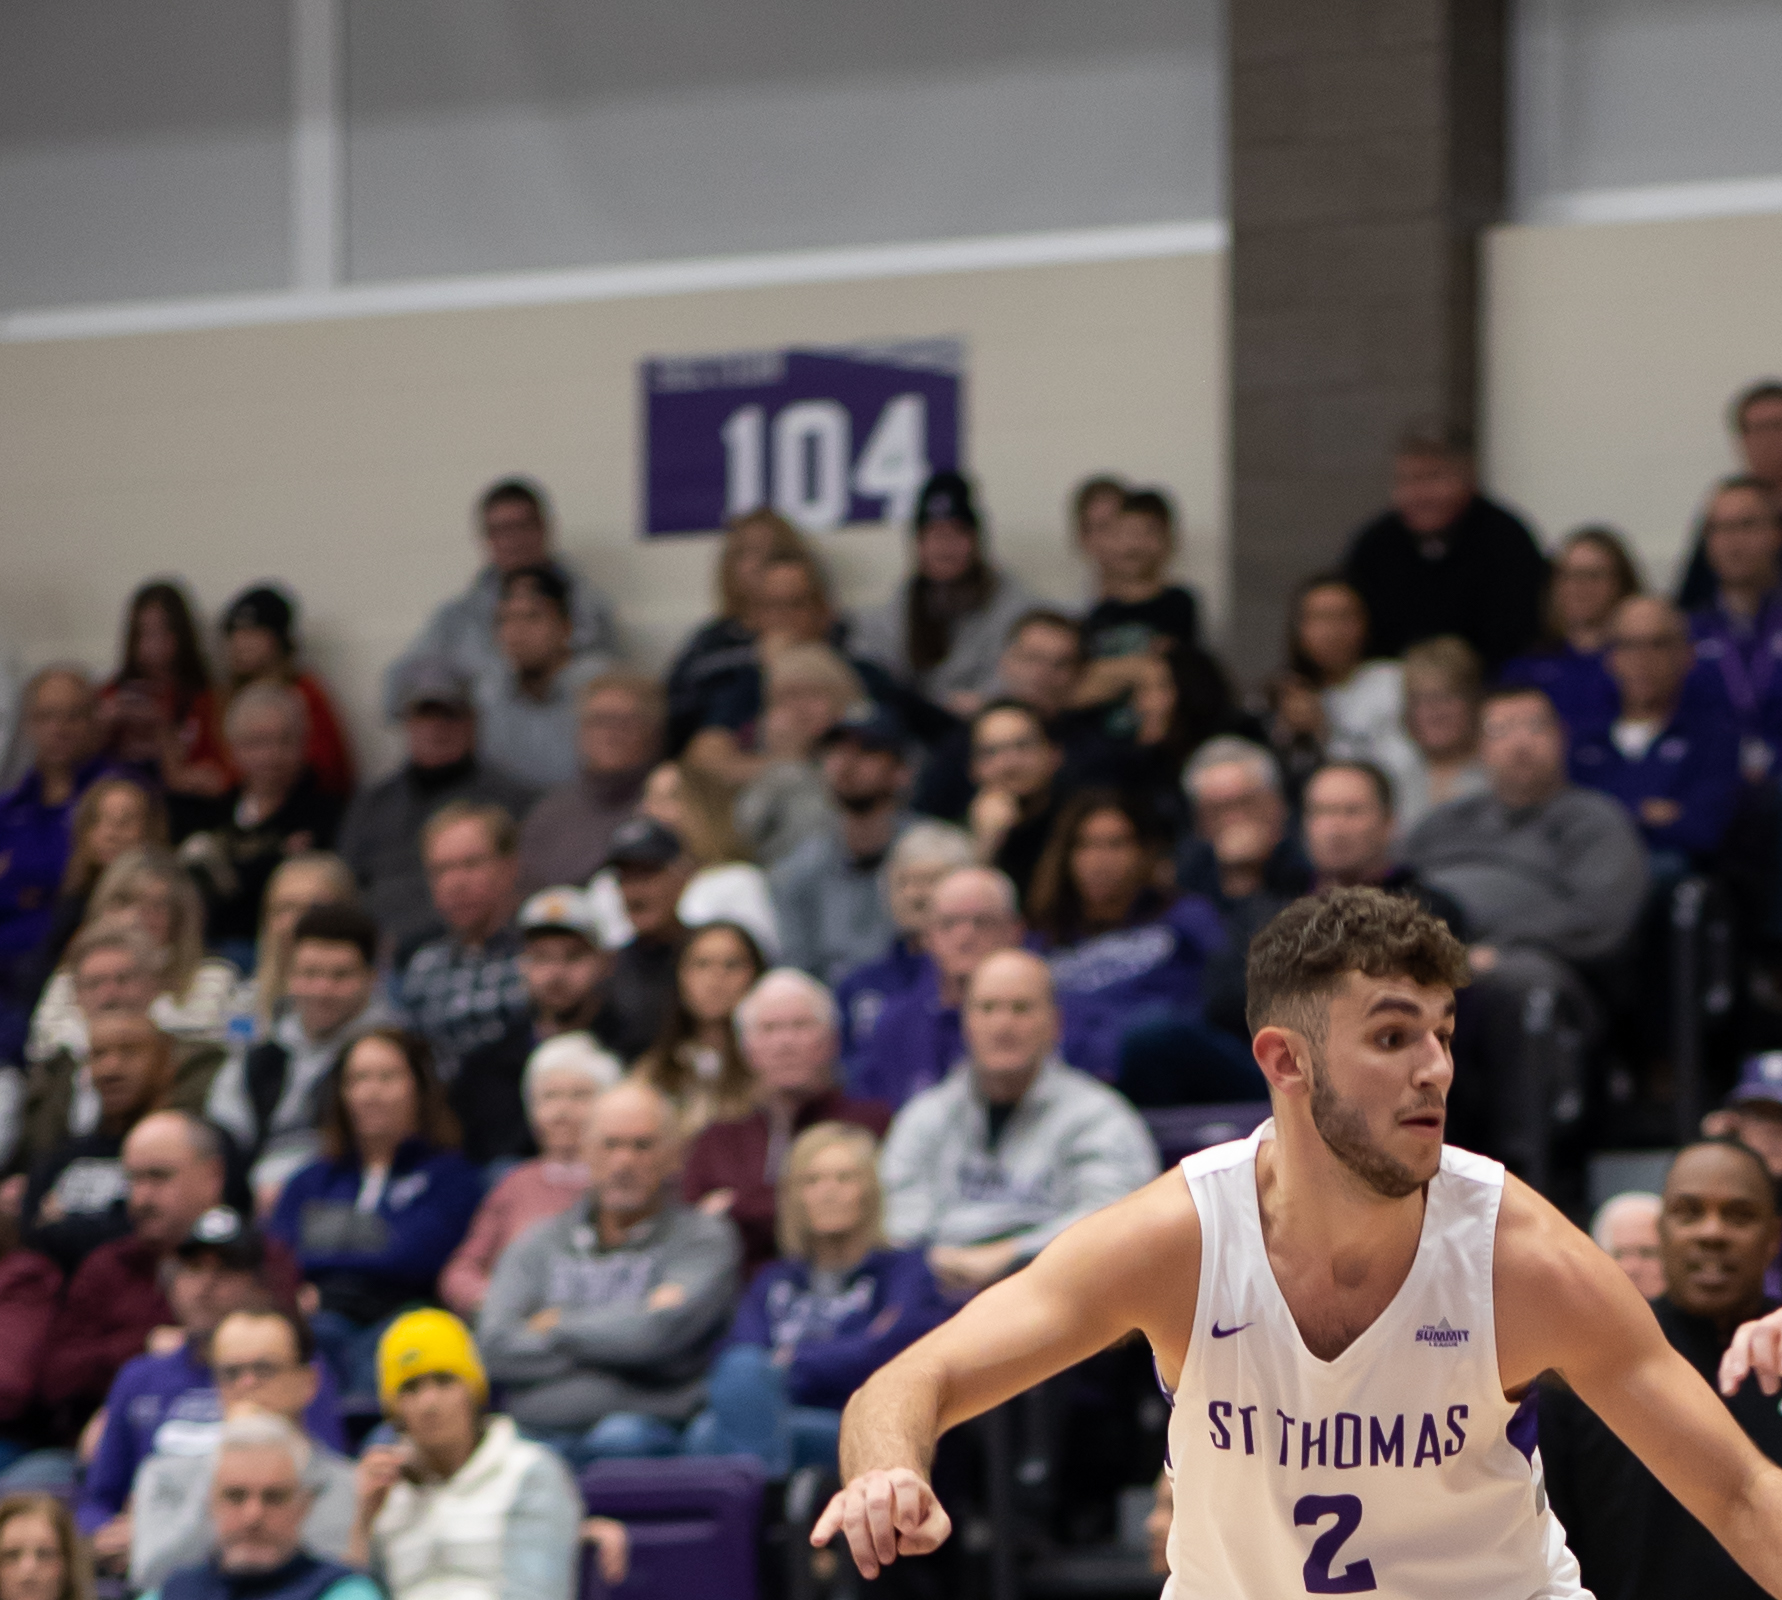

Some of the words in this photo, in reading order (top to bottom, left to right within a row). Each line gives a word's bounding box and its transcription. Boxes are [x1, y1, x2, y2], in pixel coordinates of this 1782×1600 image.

[719, 393, 933, 531] 104
[1415, 1329, 1469, 1342] SUMMIT
[1208, 1400, 1258, 1455] ST
[1276, 1404, 1469, 1470] THOMAS
[1293, 1494, 1378, 1594] 2
